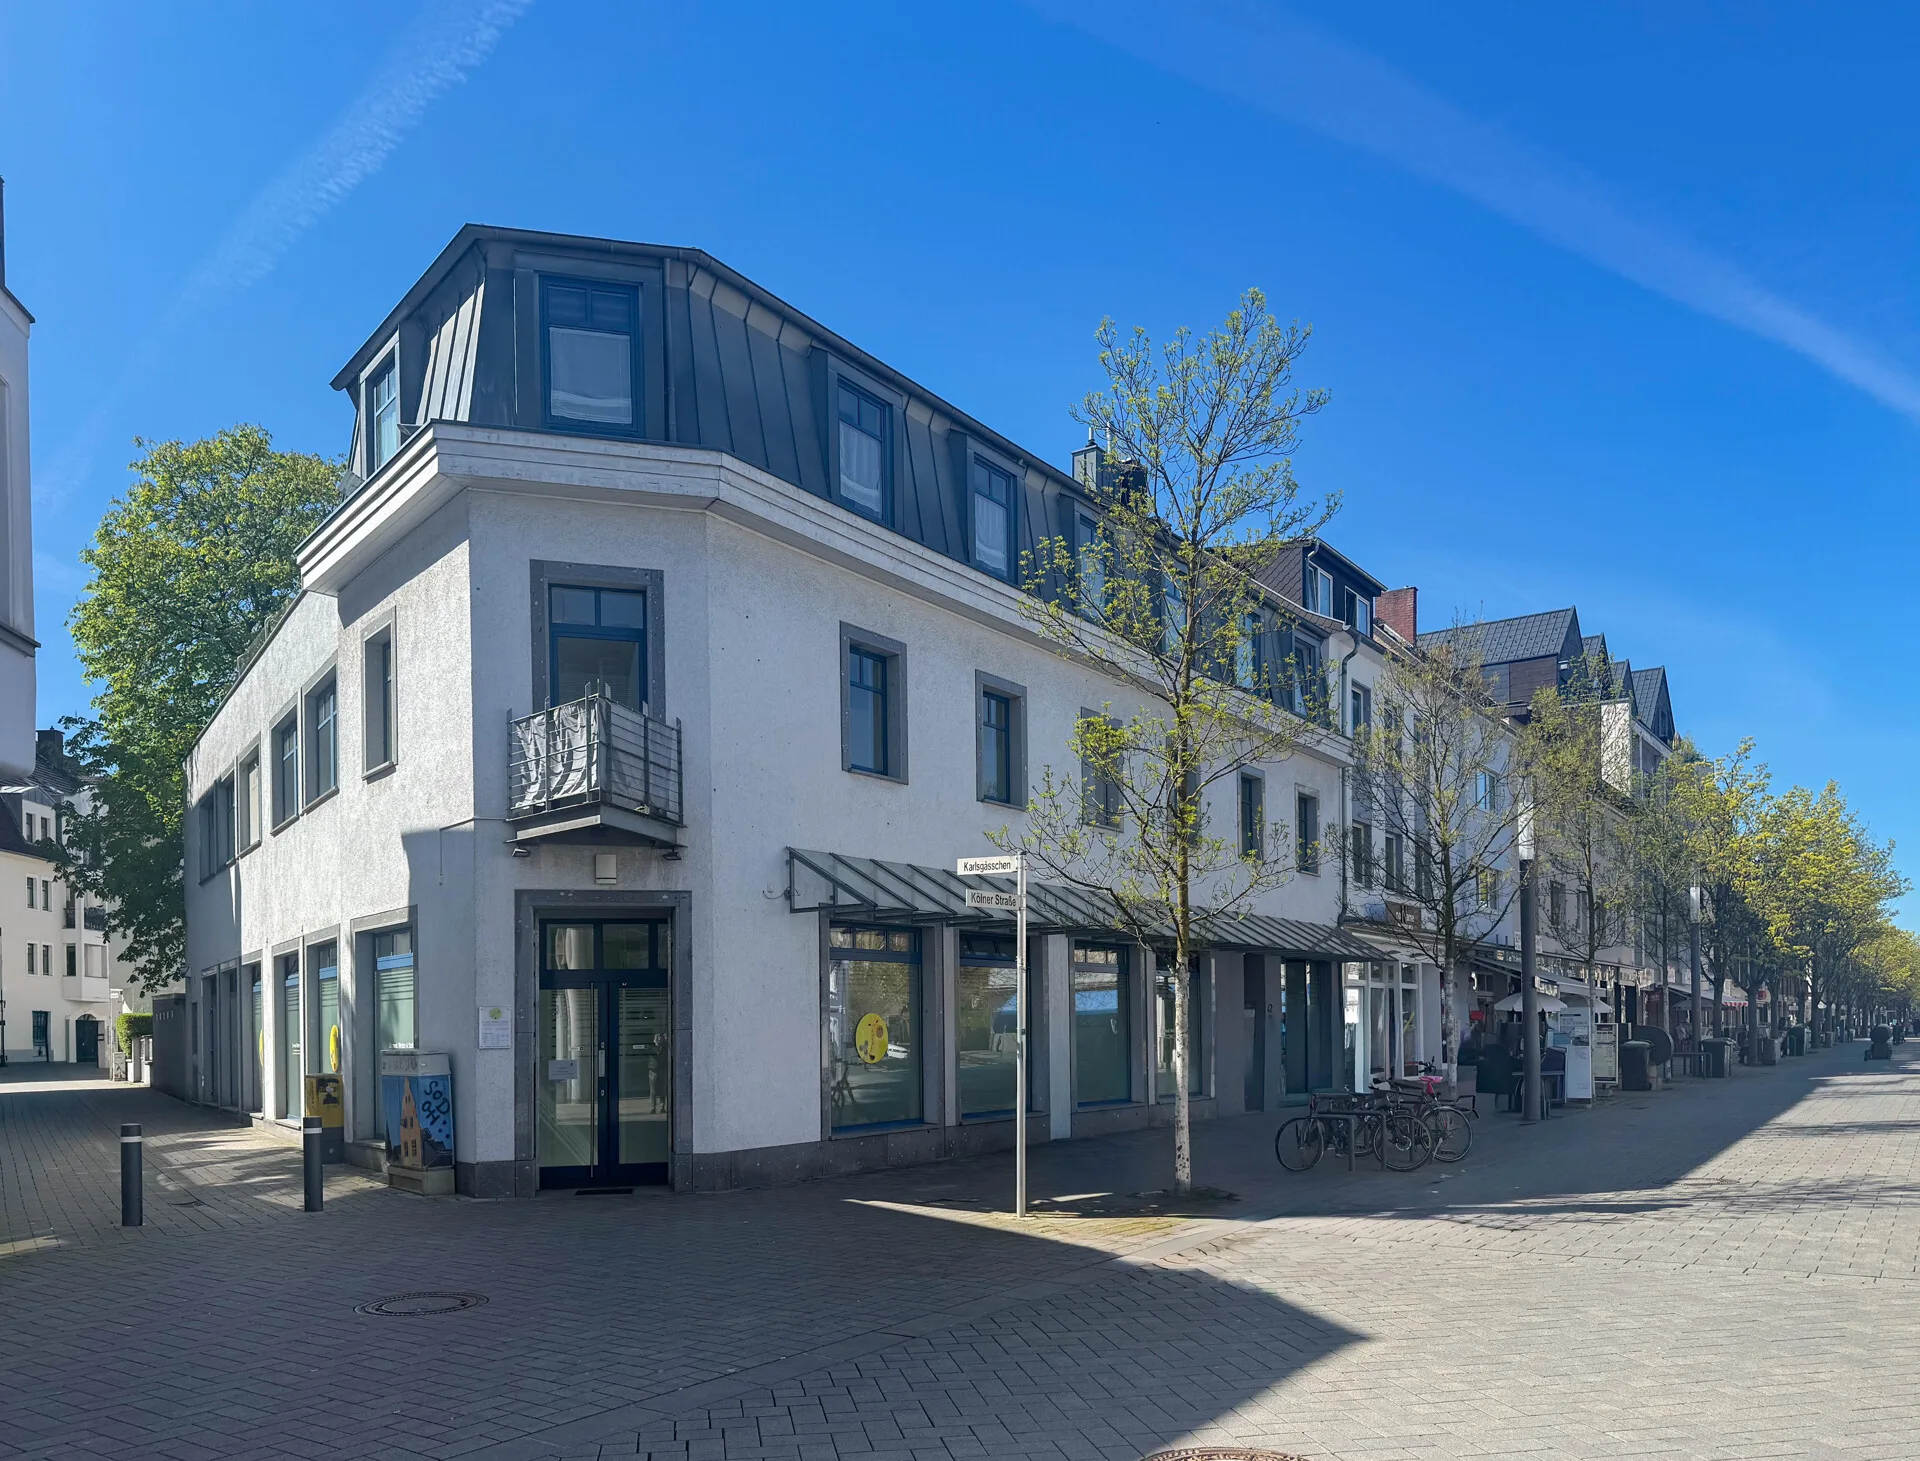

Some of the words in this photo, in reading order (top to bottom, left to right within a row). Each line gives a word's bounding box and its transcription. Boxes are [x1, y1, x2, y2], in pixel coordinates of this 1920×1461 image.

[963, 860, 1011, 872] Karlsgässchen
[971, 892, 993, 904] Kölner
[995, 894, 1016, 906] Straße
